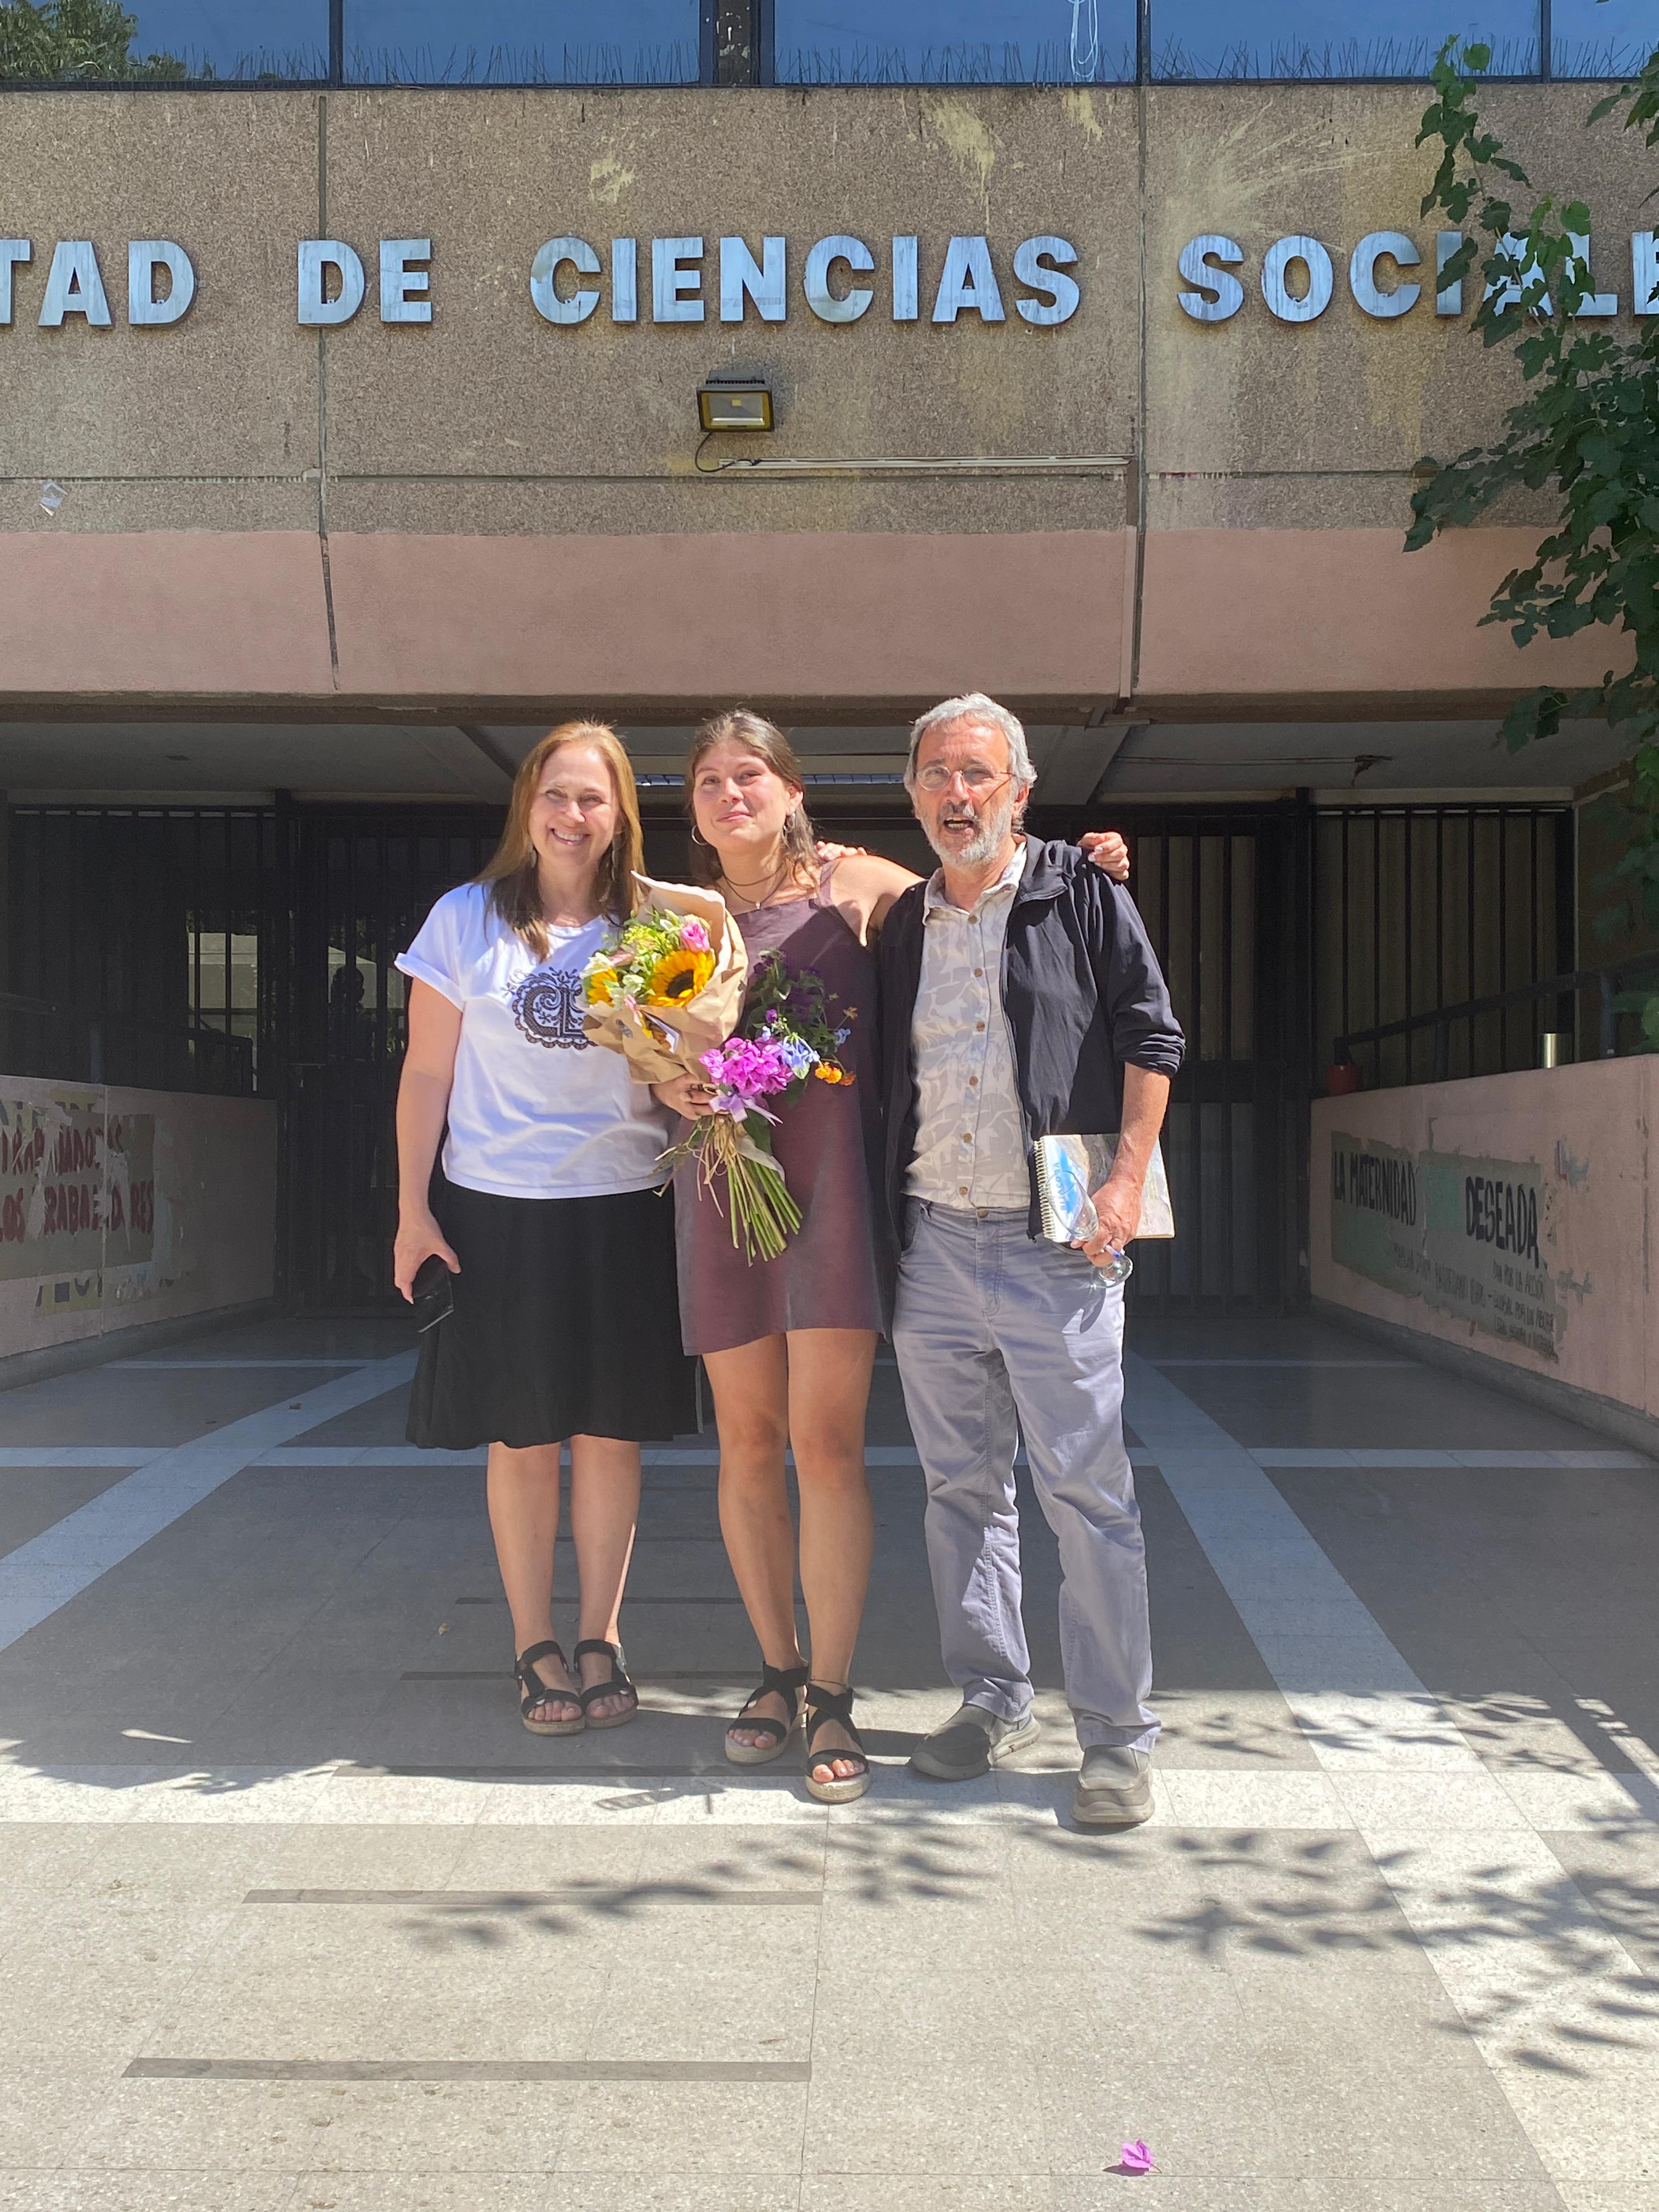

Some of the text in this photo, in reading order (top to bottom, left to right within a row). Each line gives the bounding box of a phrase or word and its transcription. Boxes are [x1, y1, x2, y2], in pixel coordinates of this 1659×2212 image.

[297, 239, 432, 325] DE
[530, 235, 1080, 326] CIENCIAS
[1334, 1150, 1417, 1226] LA MATERNIDAD
[1465, 1176, 1540, 1269] DESEADA
